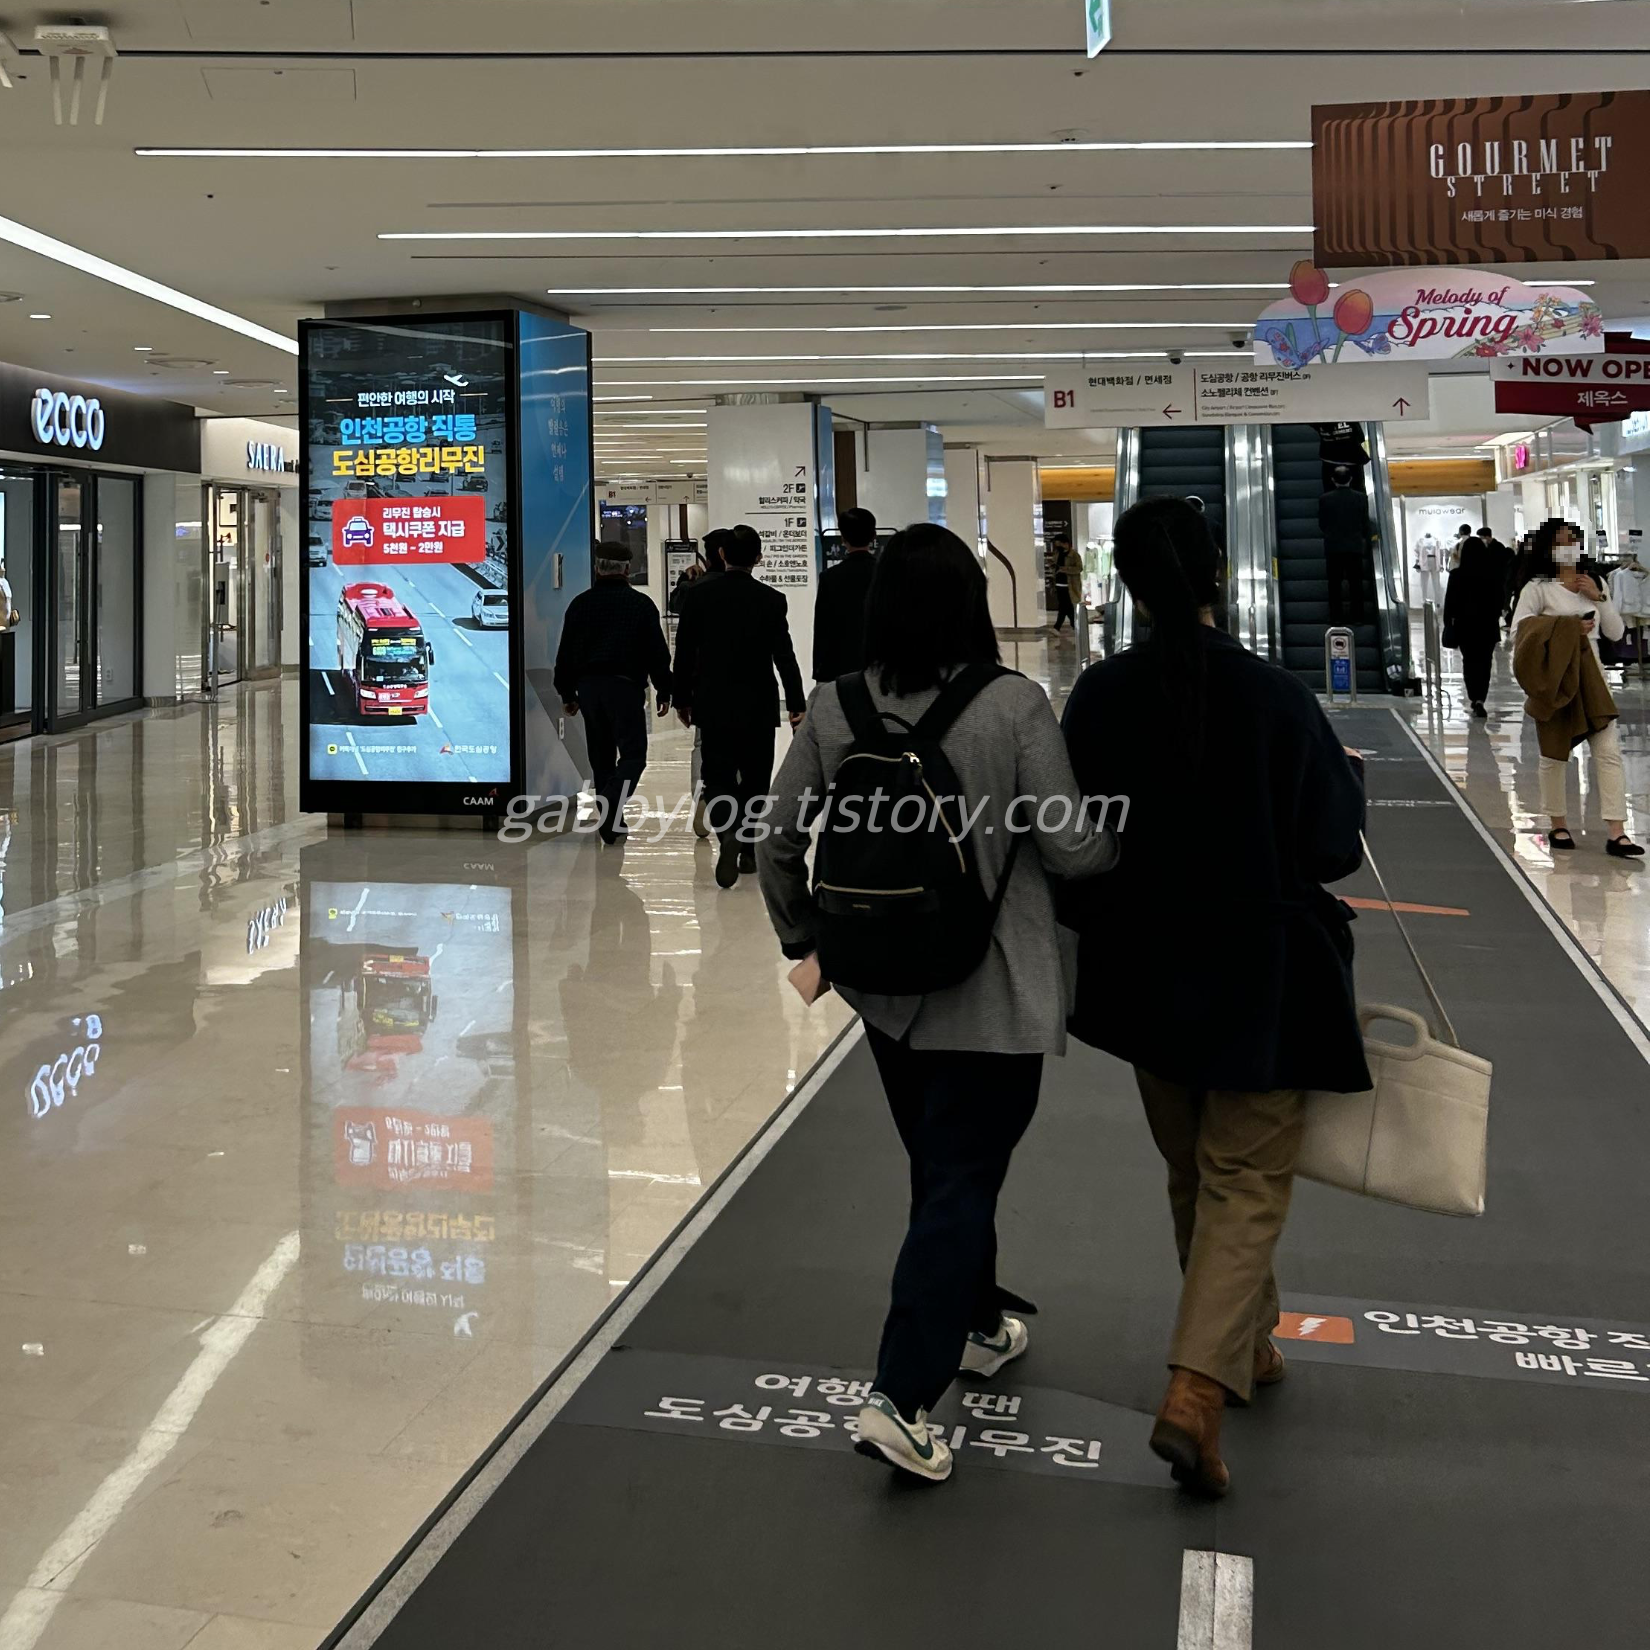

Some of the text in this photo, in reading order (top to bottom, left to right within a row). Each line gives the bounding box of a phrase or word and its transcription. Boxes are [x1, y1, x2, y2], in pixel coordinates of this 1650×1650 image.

[1430, 136, 1612, 178] GOURMET
[1447, 170, 1599, 198] STREET
[1461, 206, 1583, 222] 새롭게 즐기는 미식 경험
[1415, 286, 1511, 306] Melody of
[1388, 306, 1519, 347] Spring
[1522, 358, 1593, 377] NOW
[1088, 376, 1134, 387] 현대백화점
[1144, 375, 1172, 385] 면세점
[1200, 373, 1233, 383] 도심공항
[1241, 373, 1258, 382] 공항
[1260, 372, 1301, 381] 리무진버스
[357, 389, 455, 407] 편안한 여행의 시작
[1054, 390, 1074, 408] B1
[1244, 387, 1269, 397] 컨벤션
[1577, 390, 1628, 407] 제옥스
[31, 388, 105, 450] ecco
[340, 414, 477, 445] 인천공항 직통
[247, 440, 284, 472] SAERA
[332, 445, 485, 476] 도심공항리무진
[783, 483, 794, 493] 2F
[383, 506, 441, 519] 리무진 탑승시
[383, 520, 465, 538] 택시쿠폰 지급
[784, 517, 794, 527] 1F
[383, 543, 408, 554] 5천원
[418, 541, 444, 553] 2만원
[463, 797, 494, 806] CAAM
[1363, 1310, 1598, 1350] 인천공항
[1514, 1351, 1650, 1381] 빠르
[962, 1391, 1022, 1421] 땐
